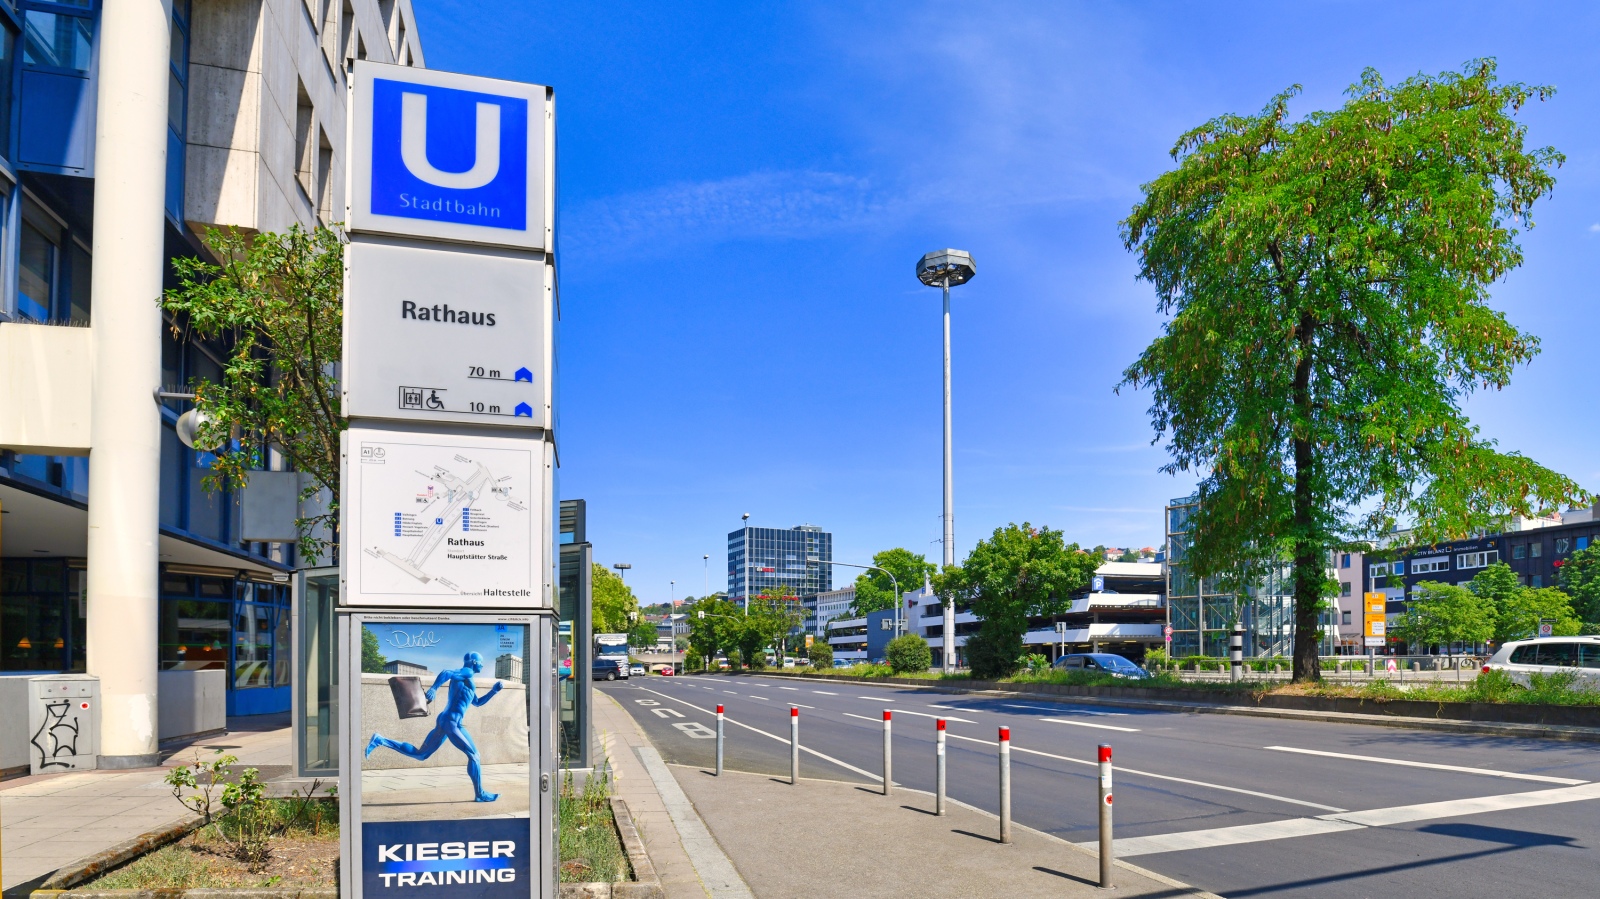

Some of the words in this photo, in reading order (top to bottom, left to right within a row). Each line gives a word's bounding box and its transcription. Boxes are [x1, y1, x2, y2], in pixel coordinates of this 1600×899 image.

[400, 92, 501, 190] U
[400, 193, 500, 218] Stadtbahn
[402, 300, 496, 326] Rathaus
[468, 366, 485, 378] 70
[490, 369, 500, 378] m
[470, 402, 485, 412] 10
[490, 404, 500, 413] m
[448, 538, 484, 546] Rathaus
[378, 840, 516, 862] KIESER
[378, 868, 516, 888] TRAINING
